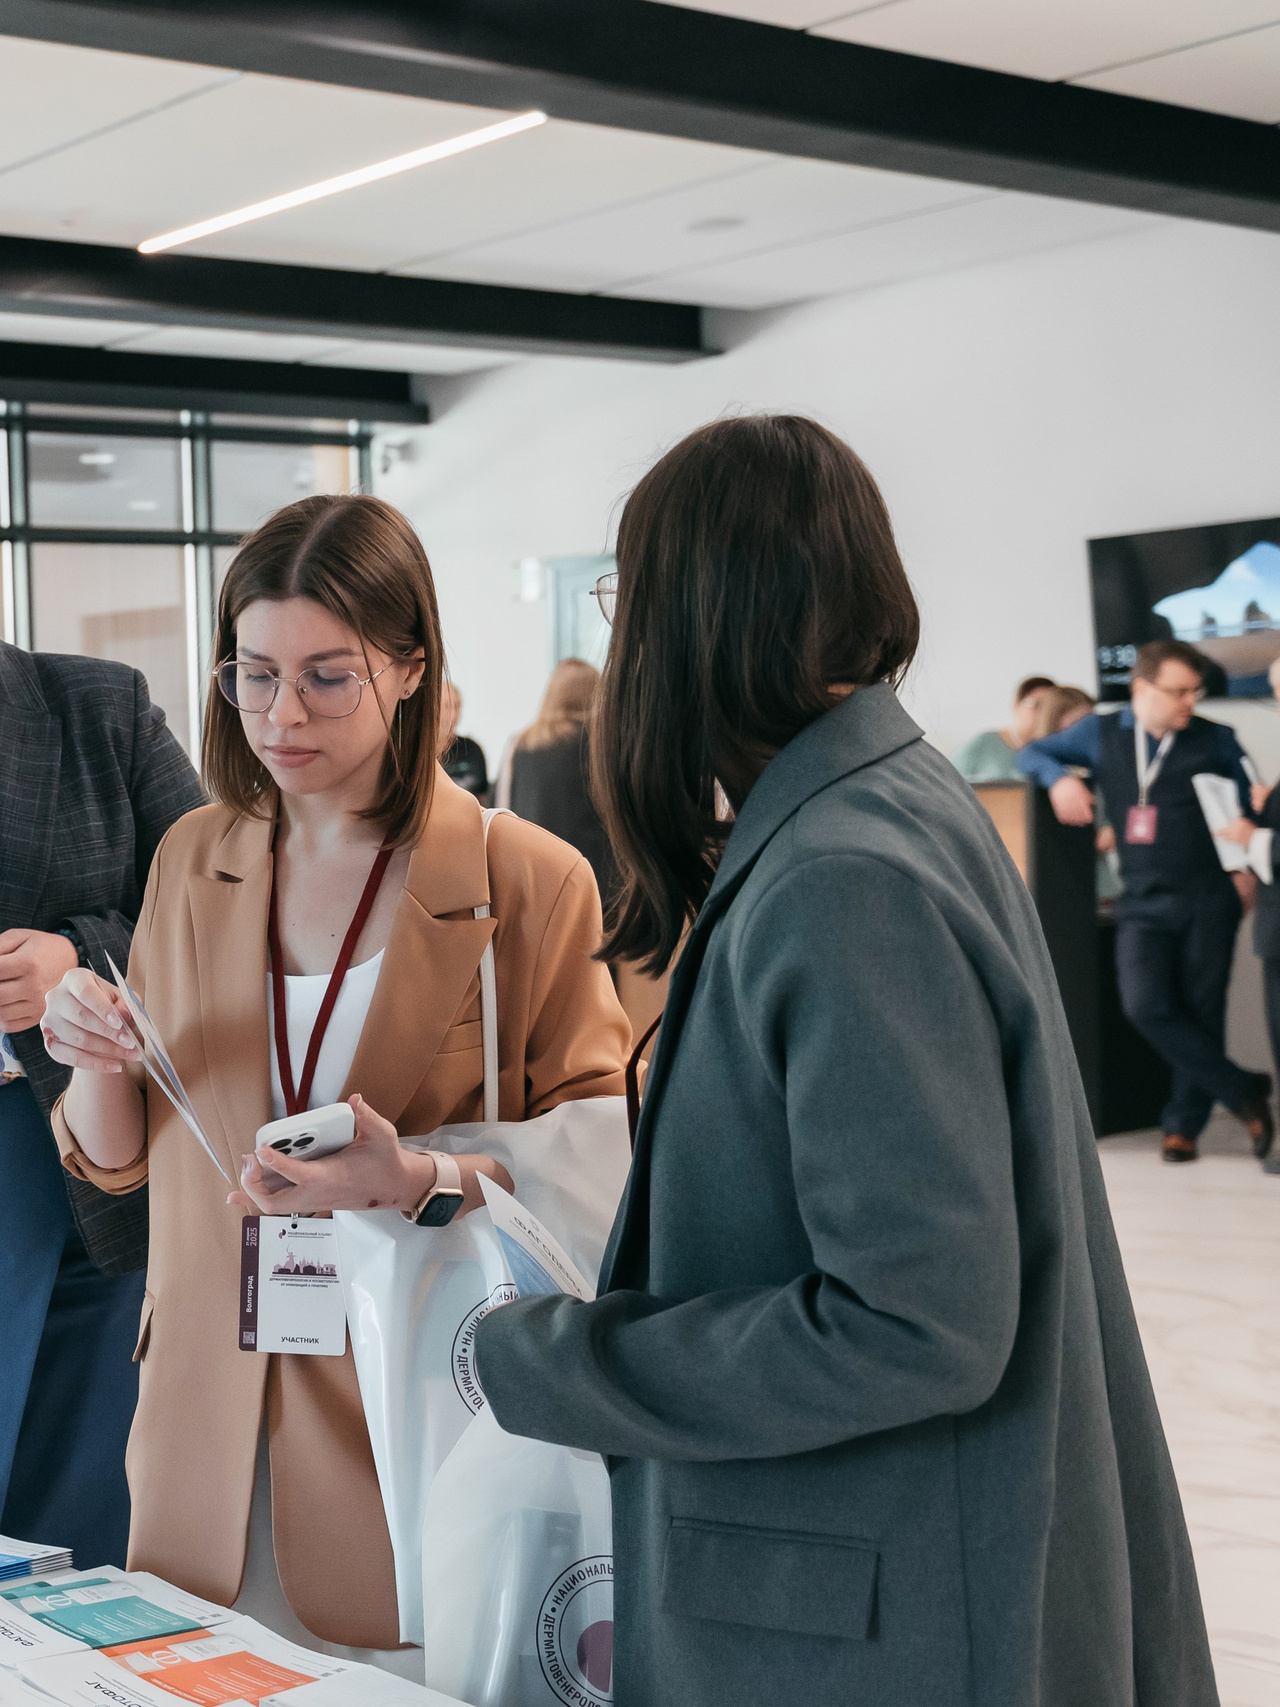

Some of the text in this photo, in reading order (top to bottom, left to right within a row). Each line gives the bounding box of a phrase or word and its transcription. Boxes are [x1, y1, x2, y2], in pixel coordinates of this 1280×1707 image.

[250, 1227, 258, 1247] 2025
[246, 1275, 254, 1313] Волгоград
[281, 1336, 320, 1344] УЧАСТНИК
